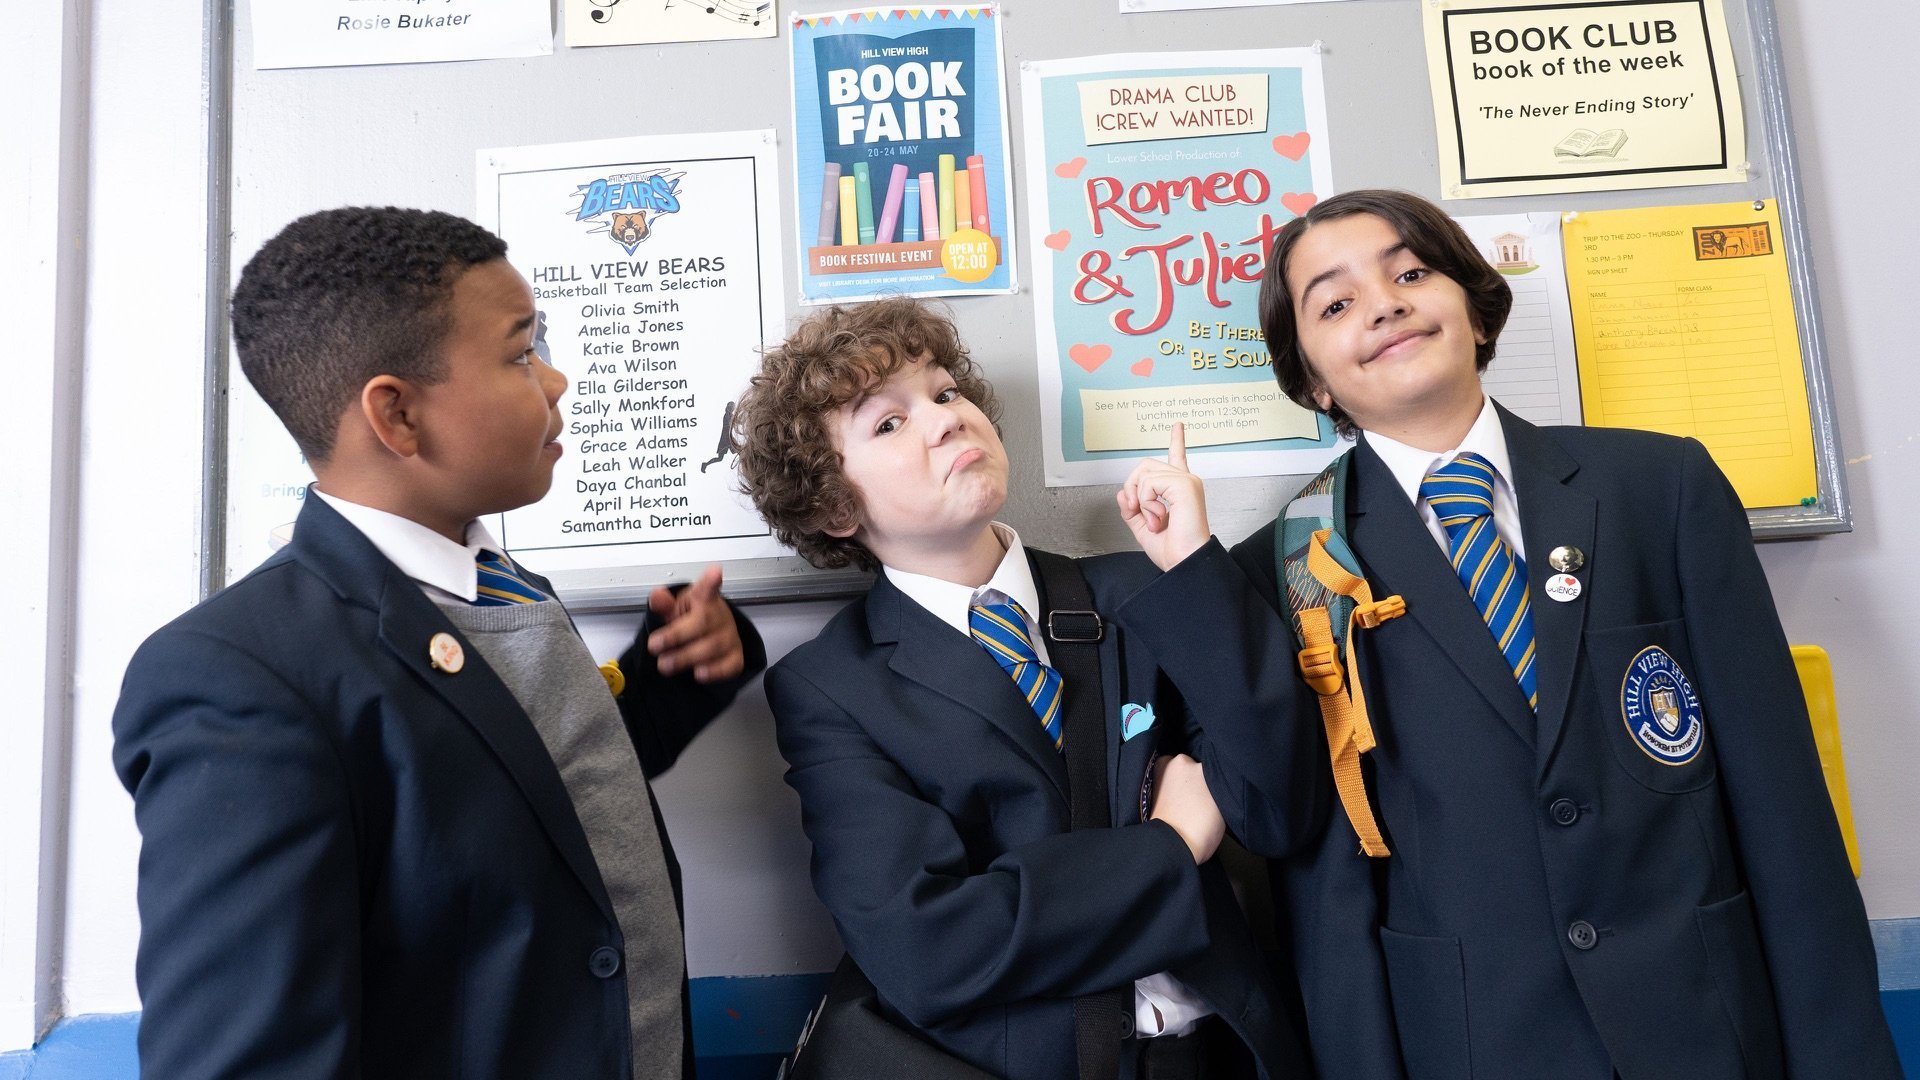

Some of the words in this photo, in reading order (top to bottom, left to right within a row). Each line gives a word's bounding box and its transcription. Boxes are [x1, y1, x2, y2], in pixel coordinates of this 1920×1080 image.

[337, 15, 391, 31] Rosie
[398, 13, 472, 29] Bukater
[1470, 26, 1572, 55] BOOK
[1583, 20, 1677, 48] CLUB
[861, 48, 881, 59] HILL
[882, 47, 905, 57] VIEW
[907, 46, 929, 56] HIGH
[1473, 60, 1534, 80] book
[1542, 57, 1565, 76] of
[1573, 55, 1612, 75] the
[1620, 51, 1685, 72] week
[827, 61, 967, 105] BOOK
[1110, 87, 1174, 106] DRAMA
[1185, 84, 1237, 103] CLUB
[1479, 105, 1514, 119] 'The
[1520, 103, 1570, 118] Never
[1575, 99, 1636, 114] Ending
[1642, 92, 1695, 111] Story'
[837, 99, 962, 146] FAIR
[1096, 112, 1159, 132] !CREW
[1169, 108, 1254, 128] WANTED!
[868, 148, 896, 158] 20-24
[900, 145, 919, 155] MAY
[1107, 153, 1137, 164] Lower
[1140, 151, 1174, 163] School
[1175, 148, 1228, 161] Production
[576, 174, 680, 221] BEARS
[1083, 168, 1271, 238] Romeo
[1611, 233, 1625, 241] THE
[1626, 232, 1641, 240] ZOO
[1648, 230, 1684, 239] THURSDAY
[819, 254, 848, 267] BOOK
[850, 251, 898, 266] FESTIVAL
[901, 249, 934, 263] EVENT
[949, 243, 973, 255] OPEN
[976, 242, 988, 254] AT
[533, 265, 582, 283] HILL
[591, 261, 649, 280] VIEW
[658, 256, 726, 276] BEARS
[951, 254, 988, 271] 12:00
[1070, 249, 1134, 305] &
[1109, 214, 1286, 336] Juliet
[534, 283, 607, 299] Basketball
[614, 281, 653, 295] Team
[660, 276, 727, 291] Selection
[581, 304, 625, 318] Olivia
[633, 299, 679, 315] Smith
[578, 322, 630, 337] Amelia
[637, 320, 684, 334] Jones
[583, 341, 624, 356] Katie
[632, 338, 680, 353] Brown
[587, 361, 617, 375] Ava
[625, 357, 677, 373] Wilson
[577, 379, 606, 395] Ella
[613, 376, 688, 393] Gilderson
[571, 400, 611, 417] Sally
[618, 394, 695, 413] Monkford
[1095, 401, 1114, 411] See
[1117, 400, 1130, 410] Mr
[1132, 398, 1163, 409] Plover
[1165, 397, 1177, 407] at
[1178, 395, 1230, 407] rehearsals
[1231, 393, 1241, 403] in
[1242, 392, 1277, 403] school
[1136, 409, 1189, 421] Lunchtime
[1191, 408, 1215, 418] from
[1218, 405, 1261, 417] 12:30pm
[570, 419, 623, 437] Sophia
[631, 414, 697, 431] Williams
[1140, 424, 1148, 433] &
[1184, 419, 1211, 431] chool
[1213, 418, 1234, 429] until
[1236, 416, 1259, 429] 6pm
[580, 440, 627, 454] Grace
[636, 435, 688, 450] Adams
[583, 457, 620, 473] Leah
[629, 454, 687, 471] Walker
[262, 483, 307, 501] Bring
[576, 479, 617, 495] Daya
[624, 473, 686, 491] Chanbal
[583, 496, 622, 516] April
[630, 494, 688, 510] Hexton
[561, 516, 642, 534] Samantha
[650, 511, 711, 528] Derrian
[1626, 675, 1643, 719] HILL
[1637, 652, 1668, 674] VIEW
[1671, 662, 1700, 708] HIGH
